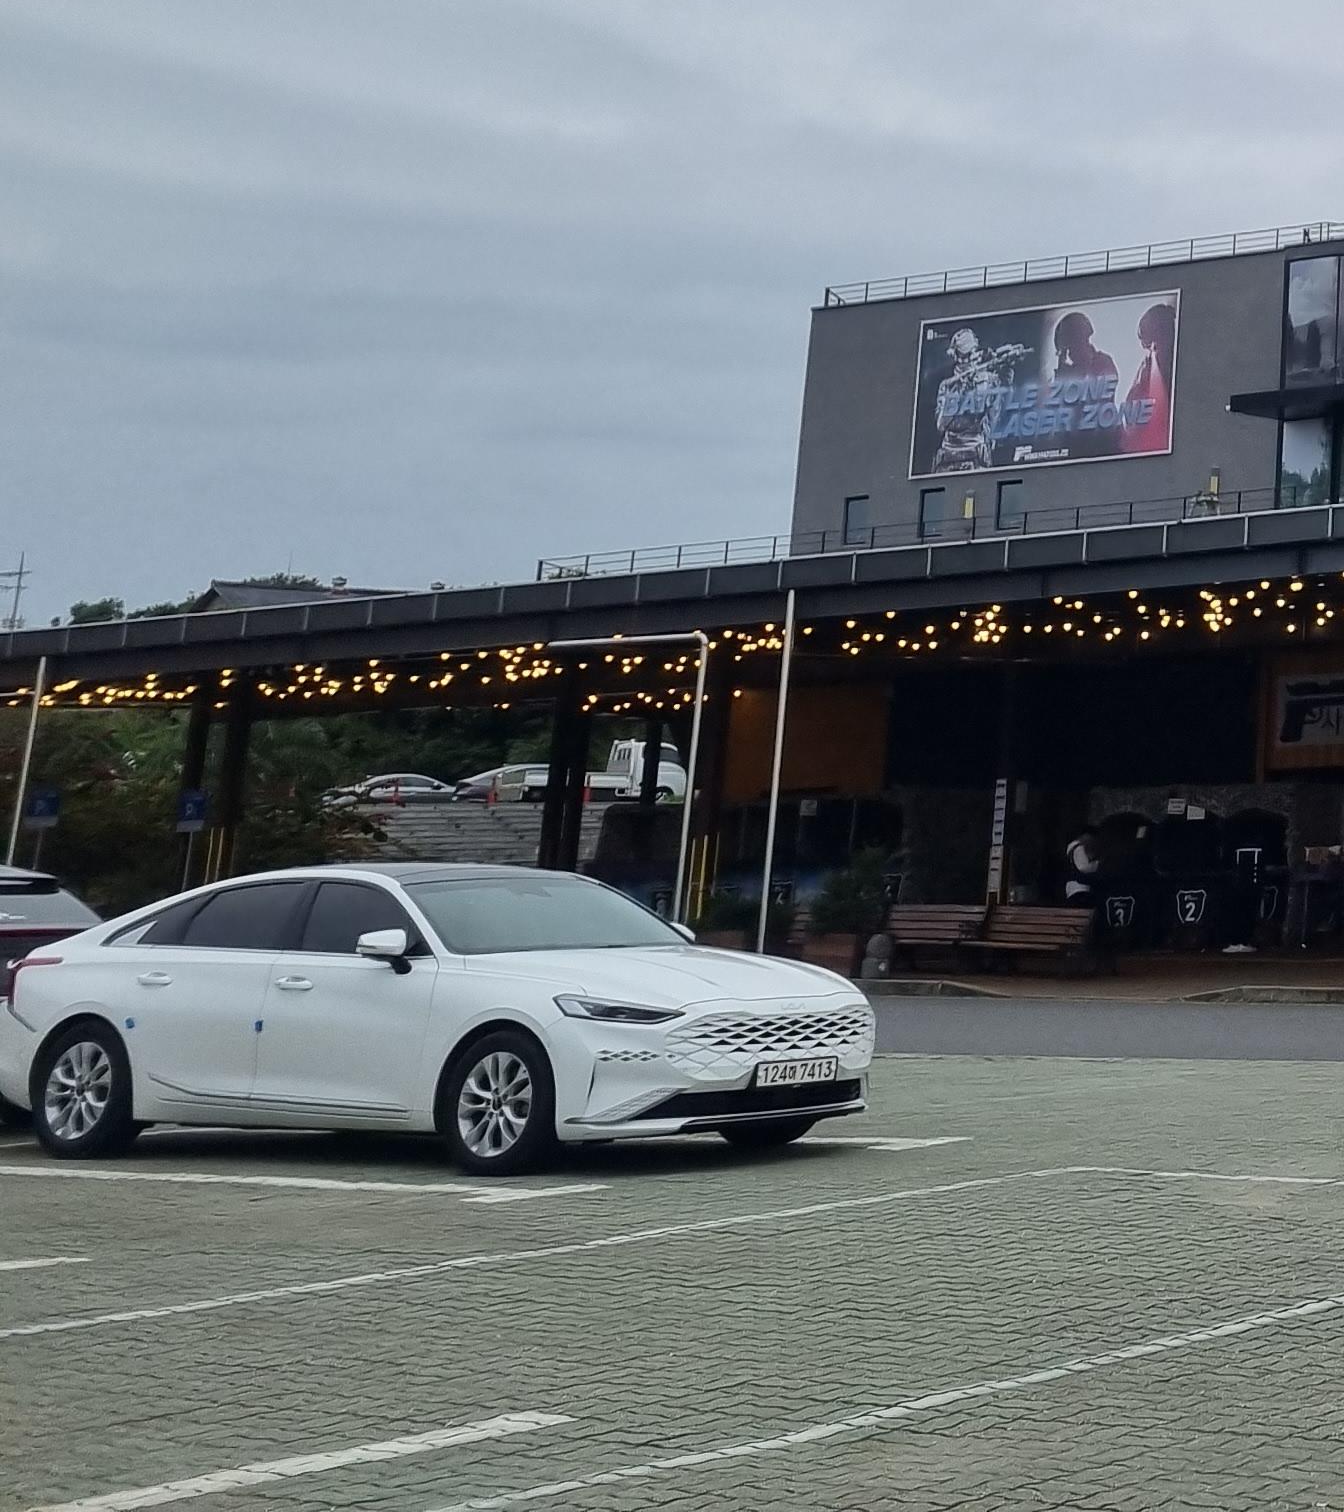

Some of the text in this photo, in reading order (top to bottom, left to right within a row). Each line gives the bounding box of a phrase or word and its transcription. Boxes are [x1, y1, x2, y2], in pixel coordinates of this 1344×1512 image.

[942, 374, 1119, 418] BATTLE ZONE
[988, 398, 1156, 439] LASER ZONE
[1185, 902, 1195, 922] 2
[800, 1061, 833, 1080] 7413
